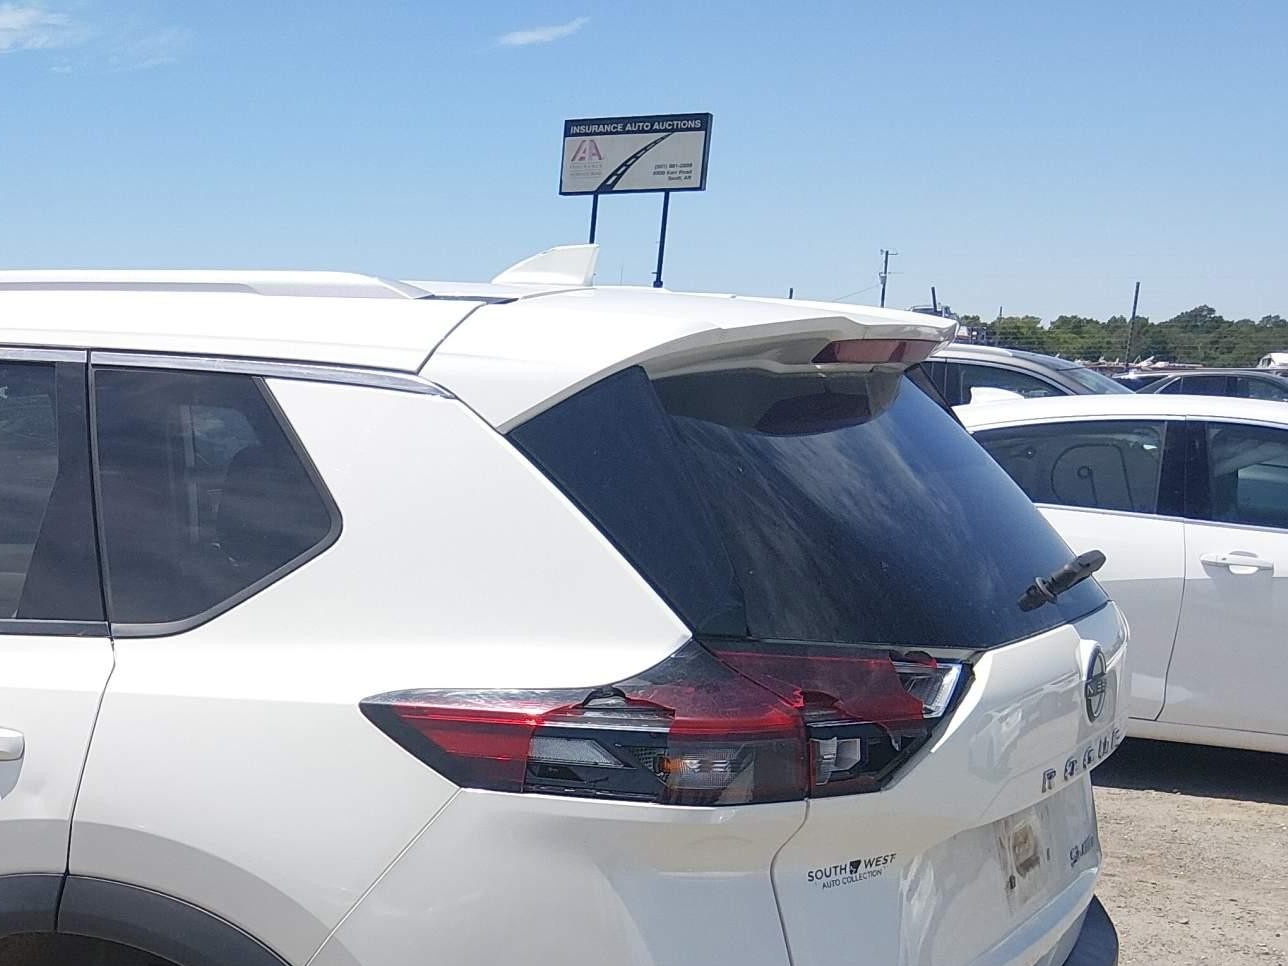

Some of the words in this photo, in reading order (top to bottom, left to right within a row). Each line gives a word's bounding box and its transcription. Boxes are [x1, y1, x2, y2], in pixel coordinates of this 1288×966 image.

[570, 123, 623, 134] INSURANCE
[625, 122, 651, 131] AUTO
[652, 120, 702, 130] AUCTIONS
[808, 864, 848, 882] SOUTH
[863, 853, 896, 869] WEST
[822, 879, 841, 890] AUTO
[842, 869, 883, 885] COLLECTION
